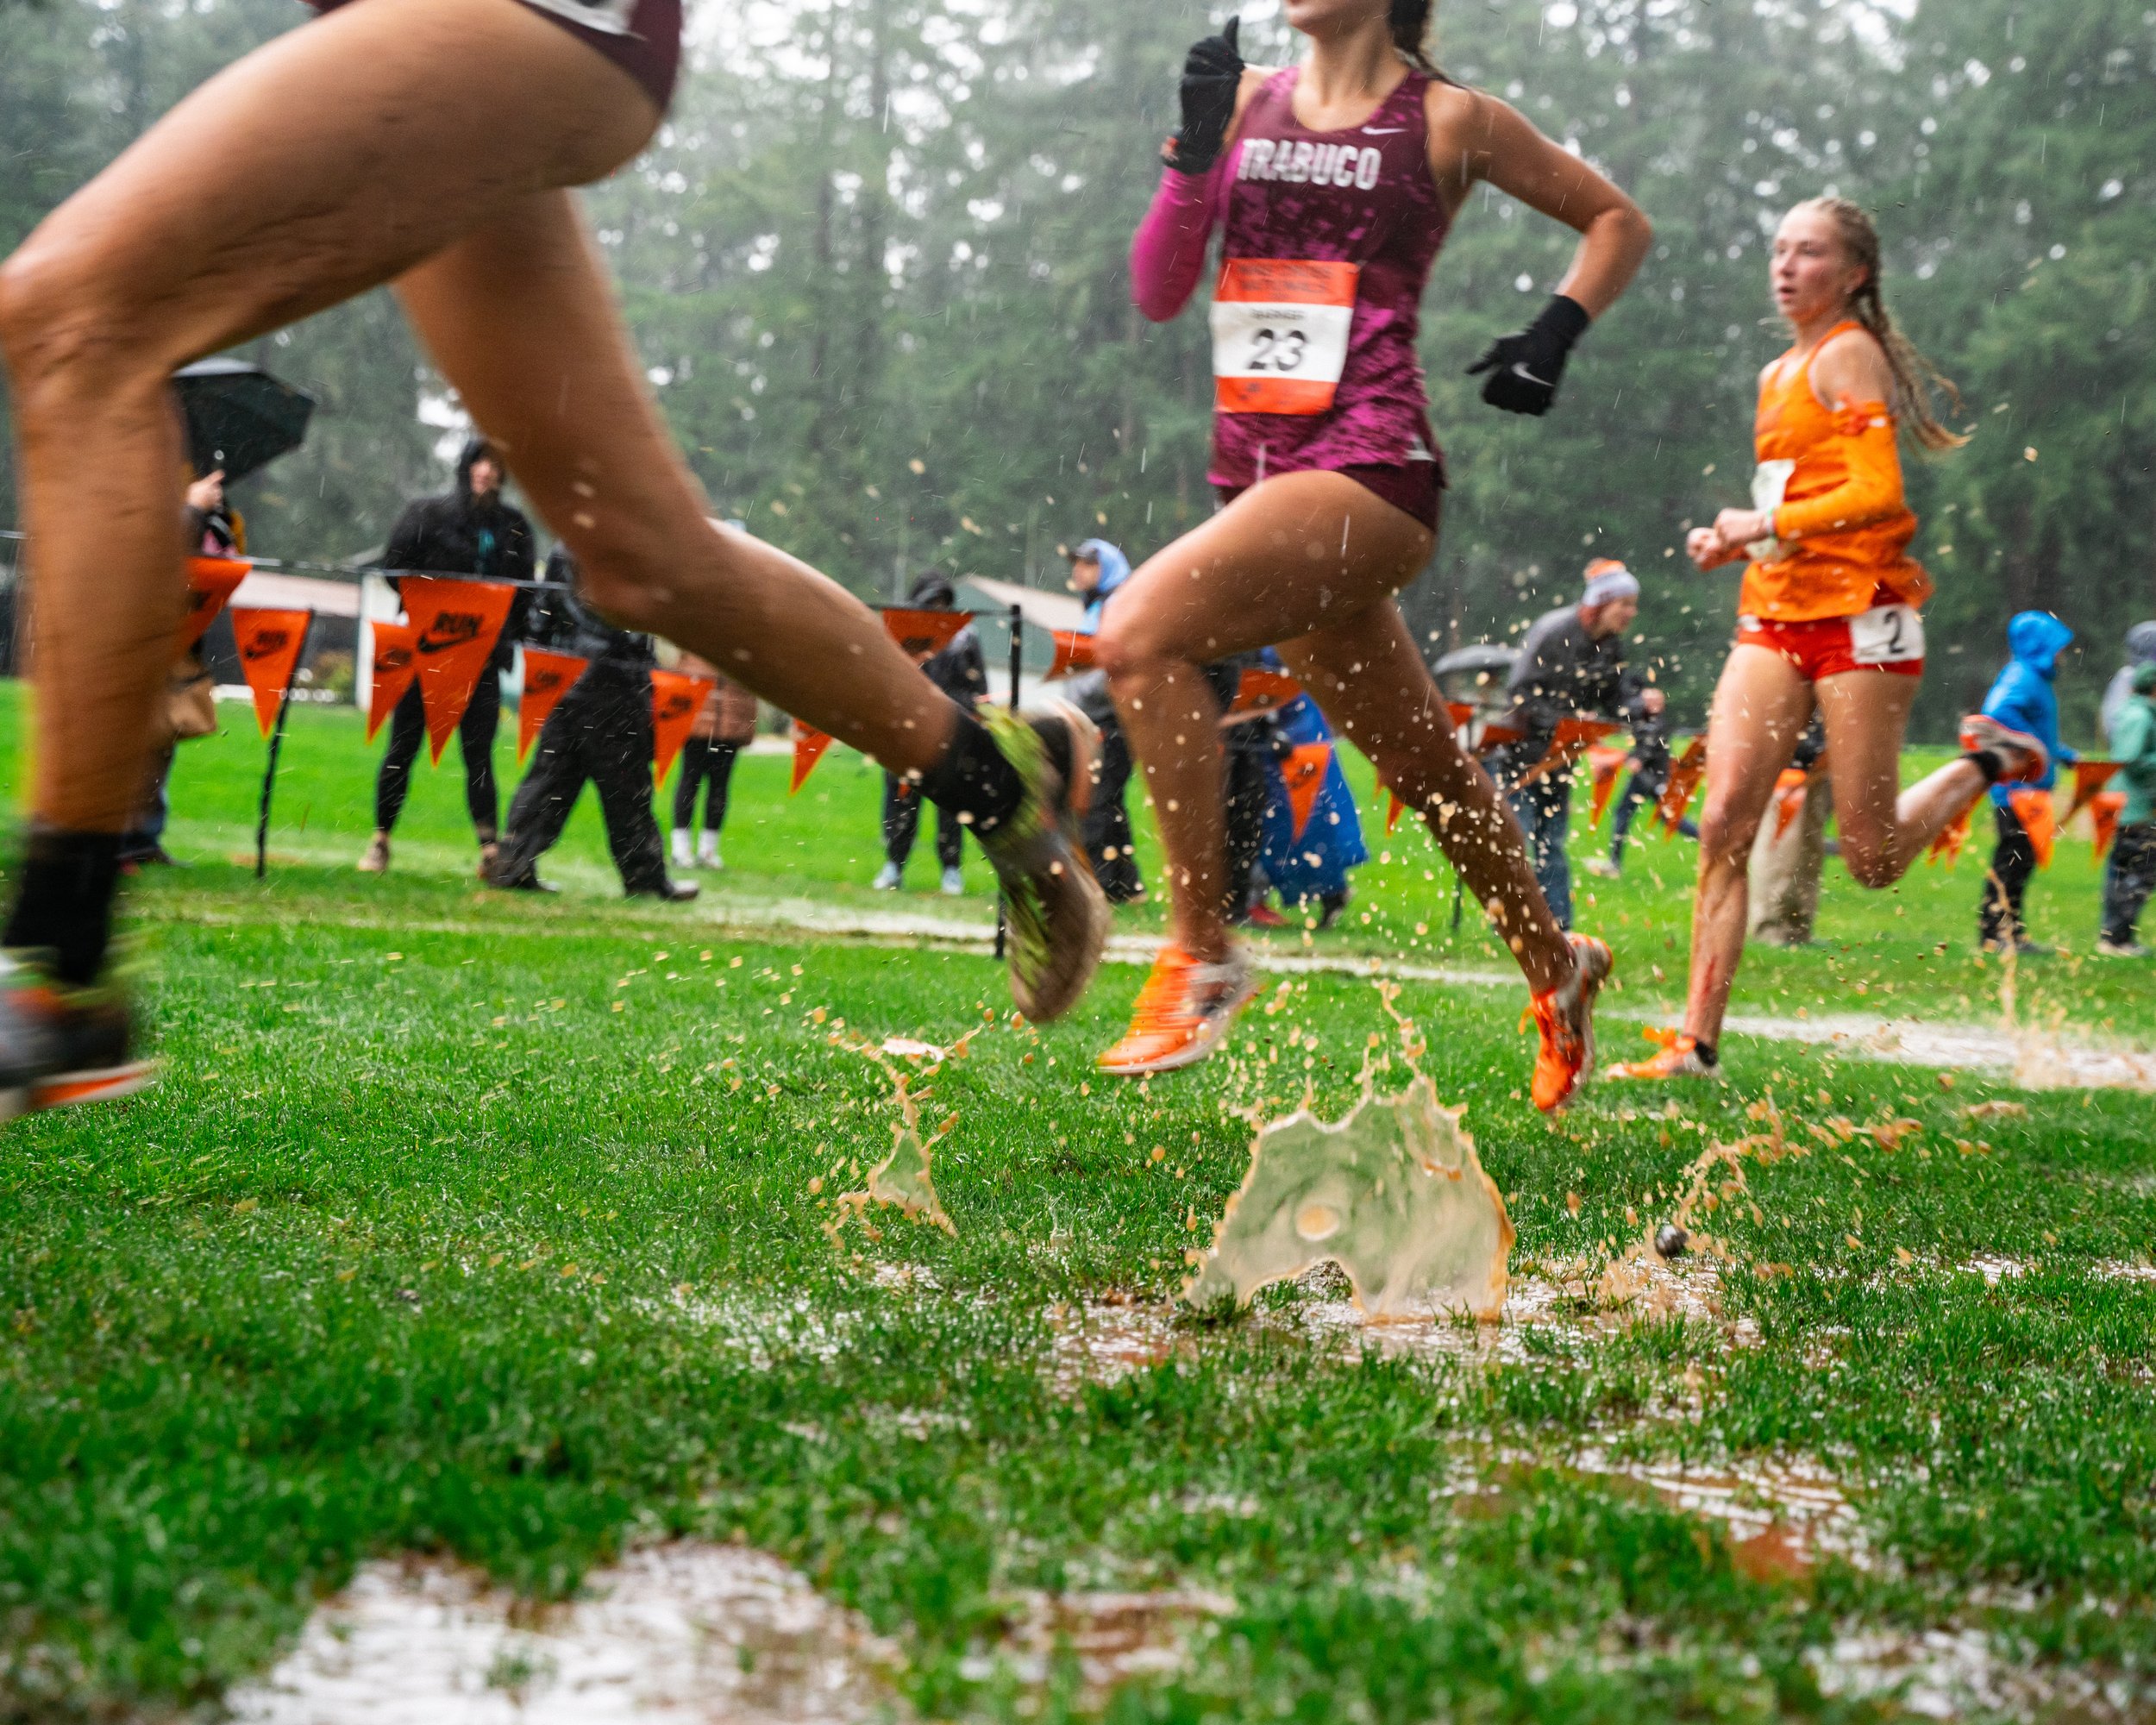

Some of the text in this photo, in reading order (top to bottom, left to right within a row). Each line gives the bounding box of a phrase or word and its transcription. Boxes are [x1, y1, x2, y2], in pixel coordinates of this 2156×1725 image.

[1247, 329, 1308, 372] 23
[432, 611, 484, 637] RUN
[1883, 610, 1906, 655] 2
